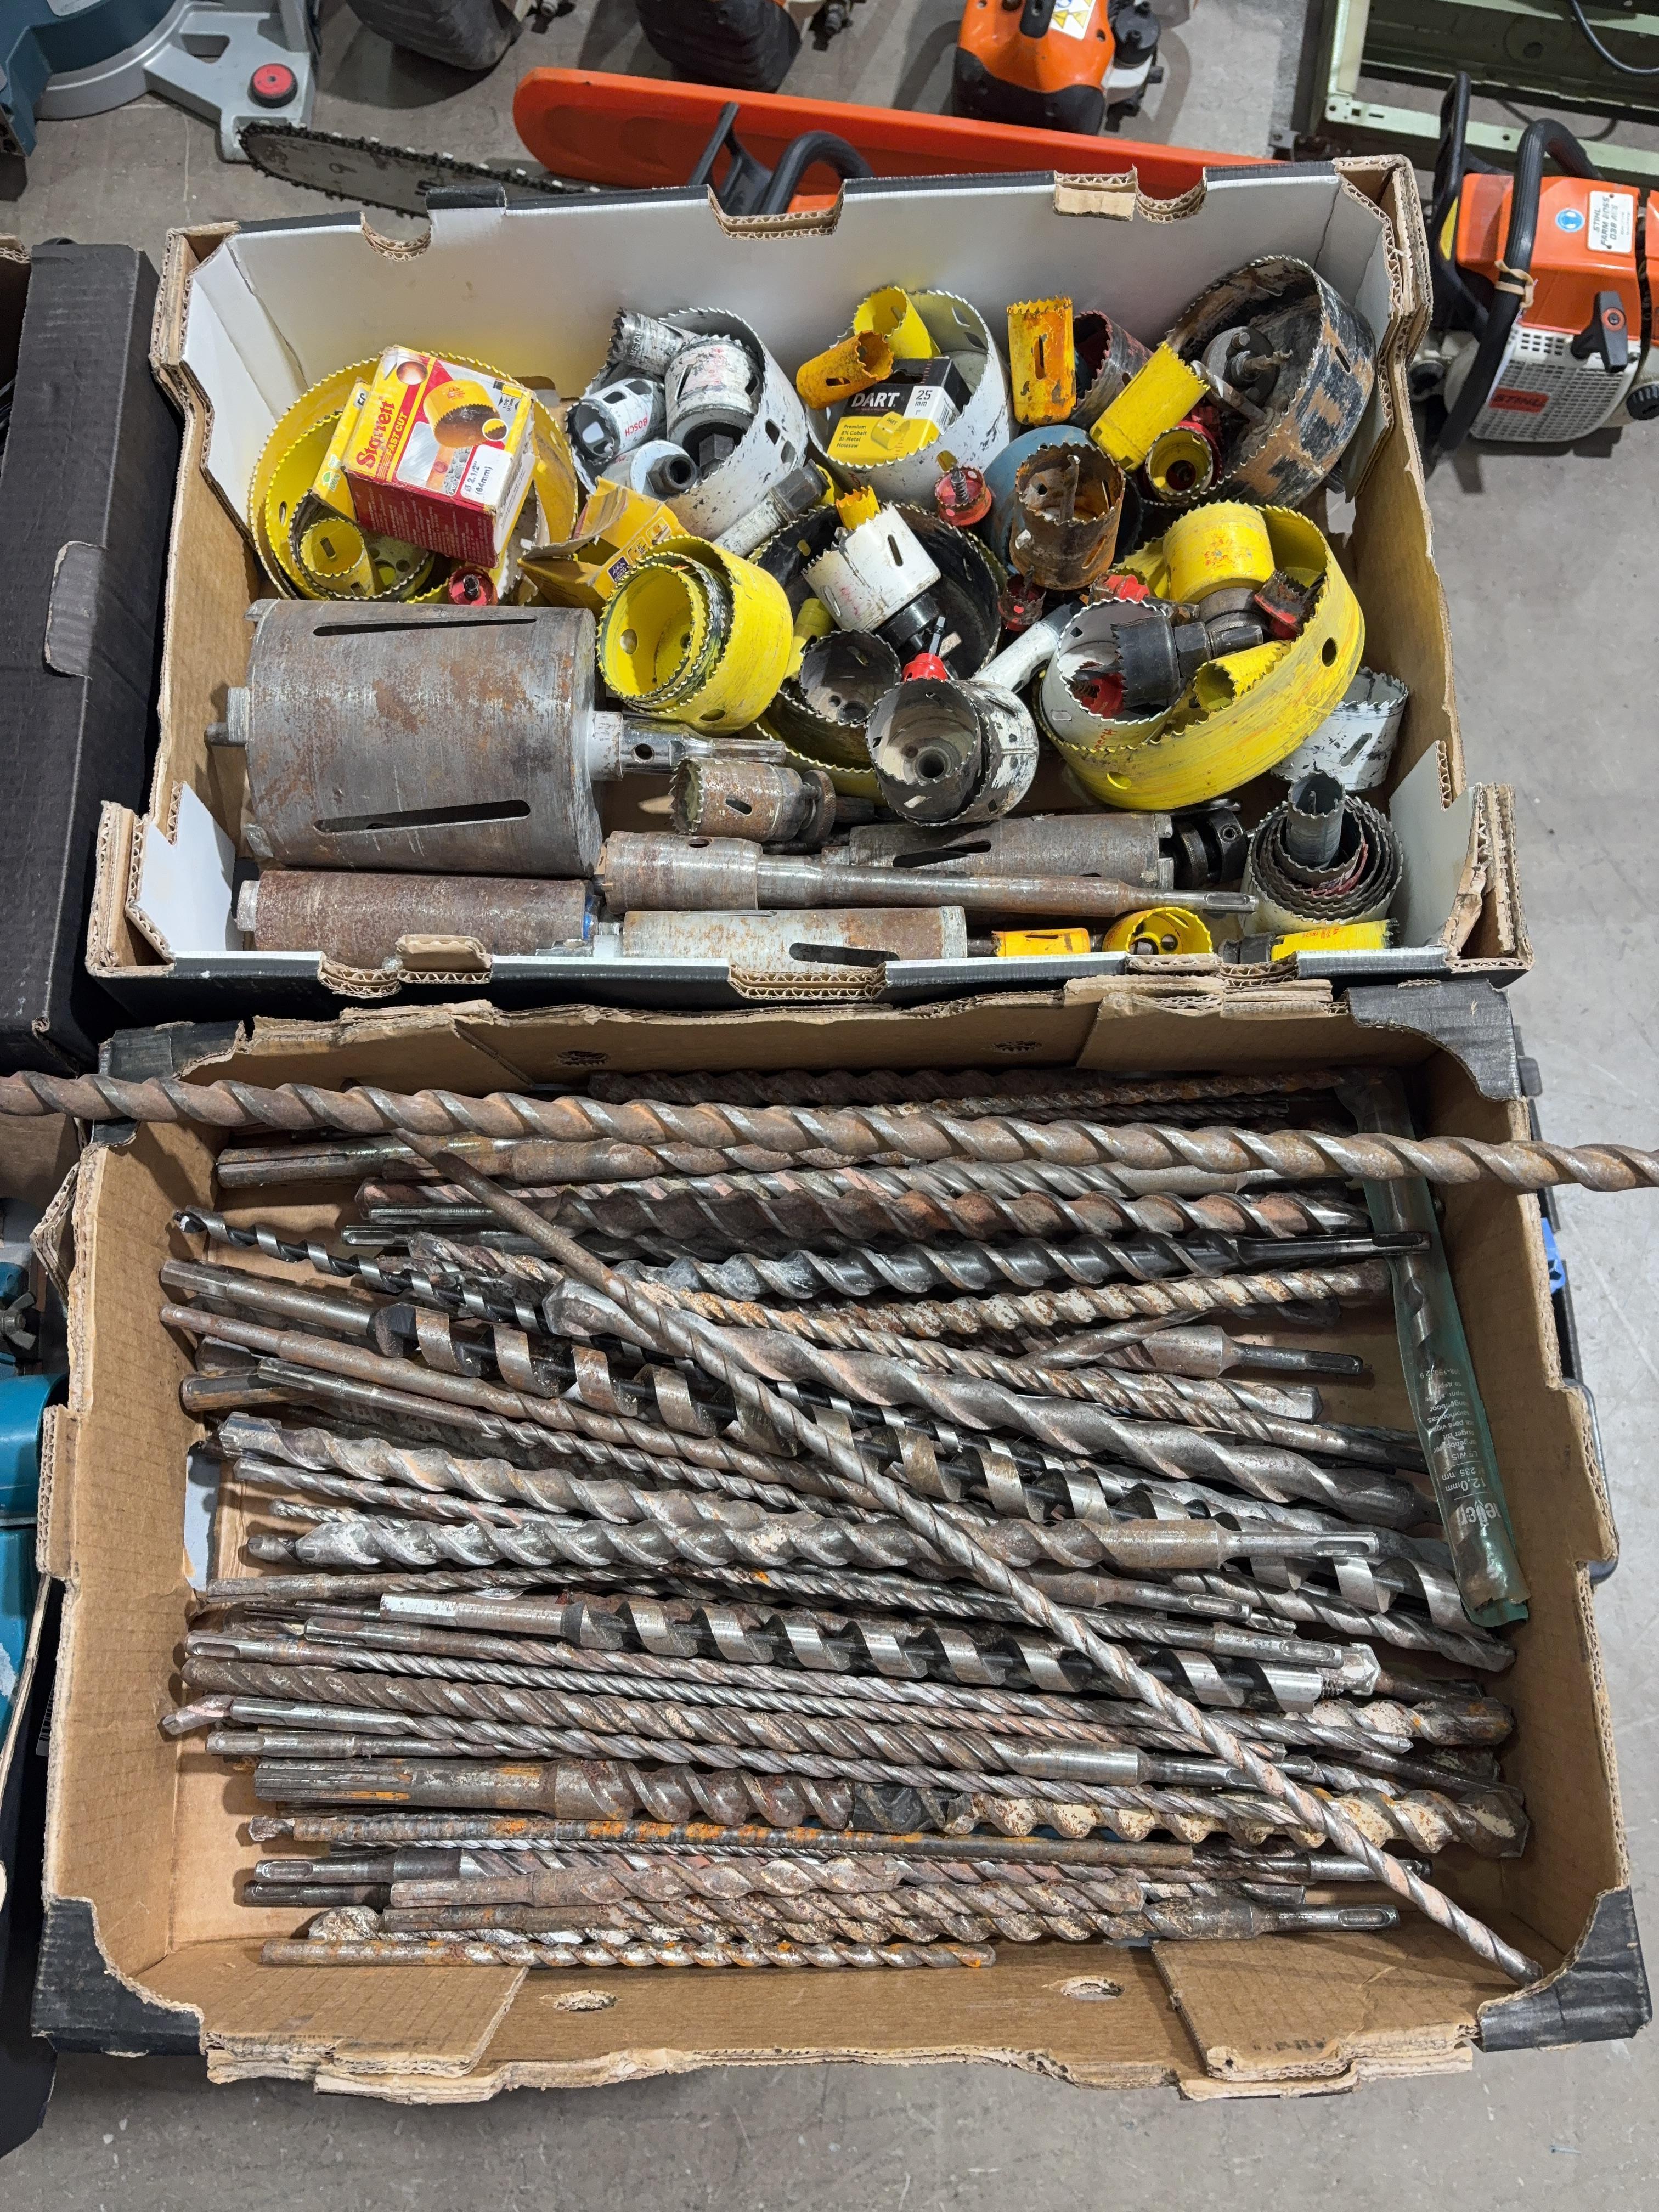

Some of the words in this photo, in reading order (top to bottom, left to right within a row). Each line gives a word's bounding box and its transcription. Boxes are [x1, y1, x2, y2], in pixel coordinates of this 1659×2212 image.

[851, 392, 900, 407] DART
[916, 390, 933, 400] 25
[356, 400, 395, 469] Starrett
[625, 416, 647, 437] BOSCH
[475, 466, 493, 495] (64mm)
[1460, 1467, 1476, 1476] 235
